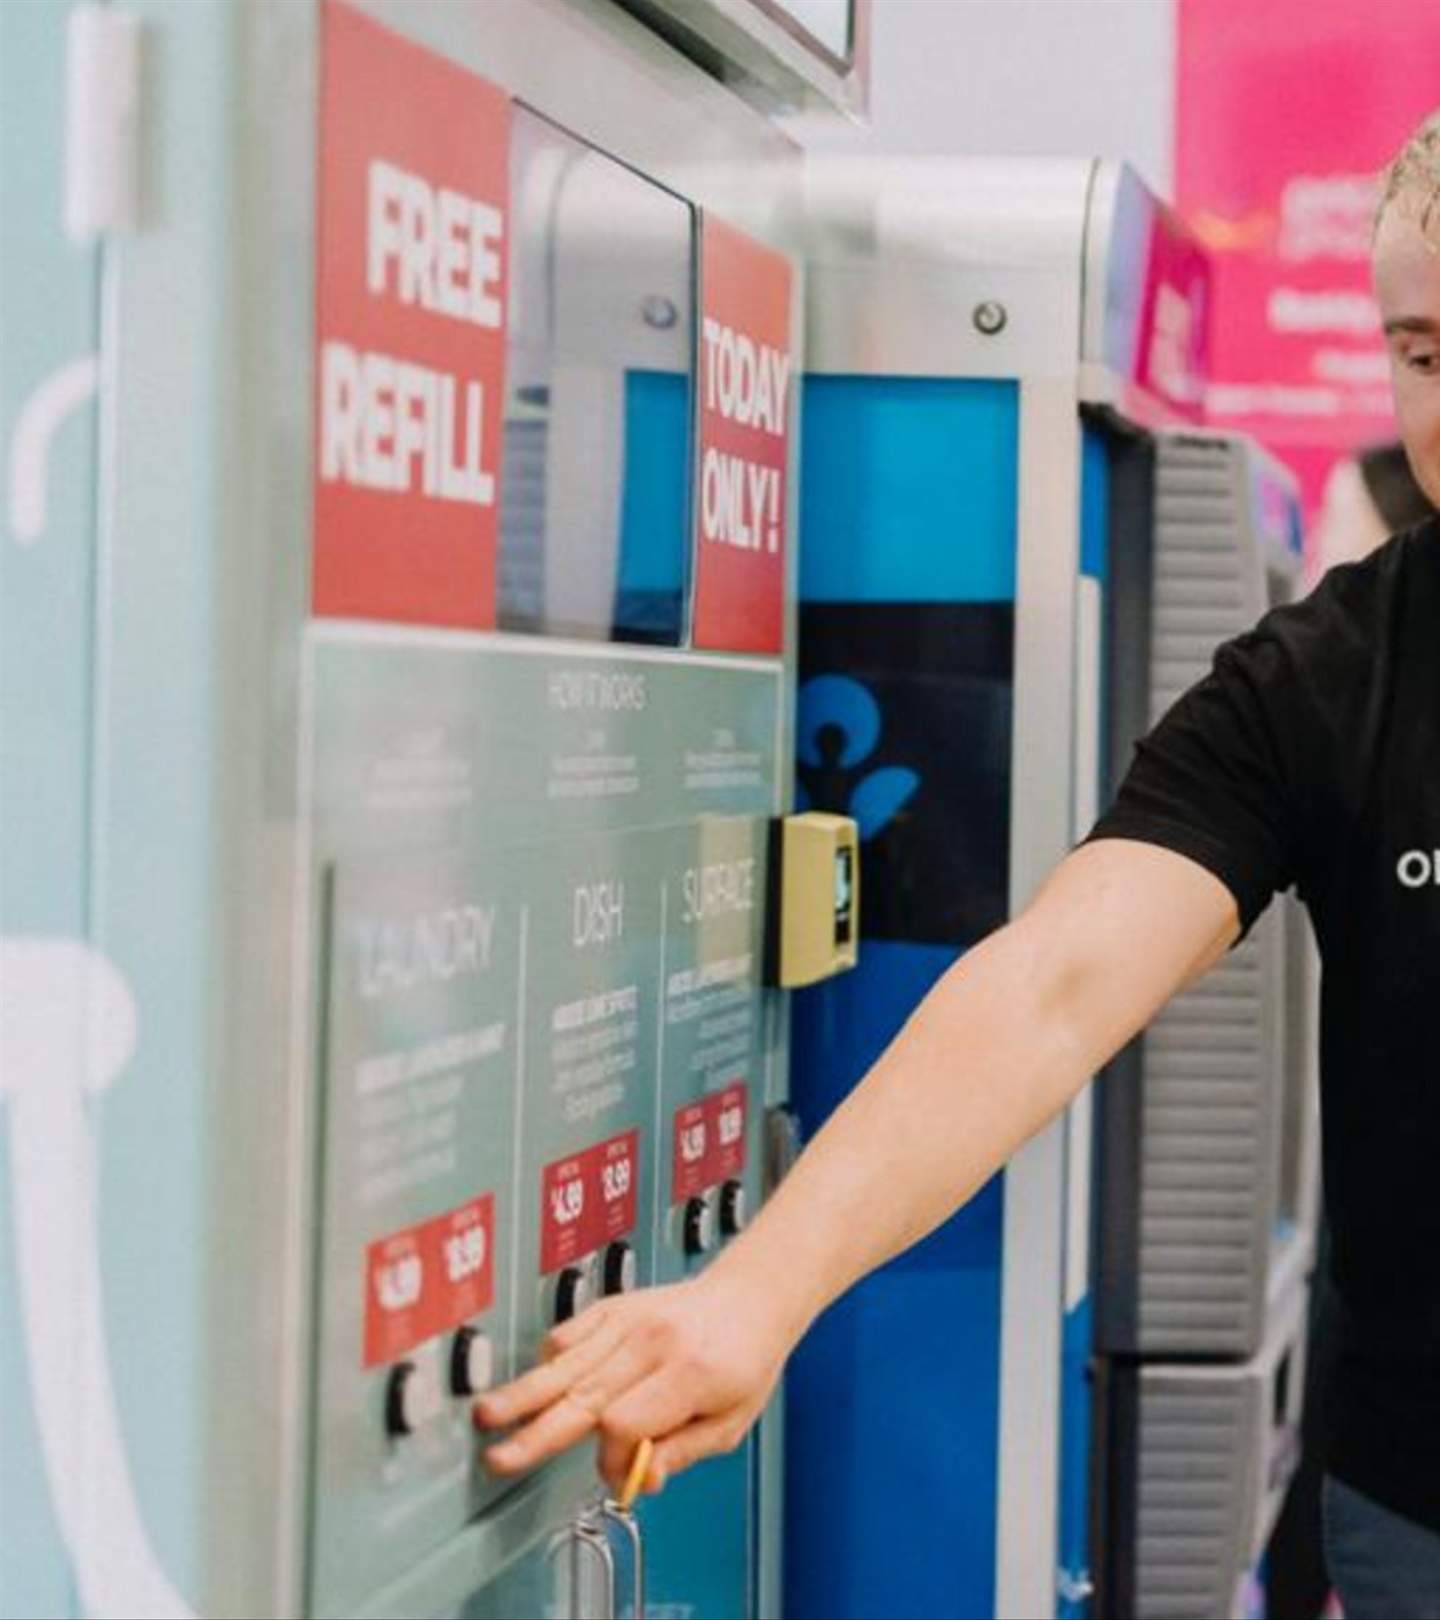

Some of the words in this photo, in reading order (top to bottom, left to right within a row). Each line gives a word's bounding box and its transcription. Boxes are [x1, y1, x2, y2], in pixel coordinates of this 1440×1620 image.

[366, 159, 503, 328] FREE
[319, 339, 495, 508] REFILL
[702, 318, 790, 436] TODAY
[702, 446, 782, 554] ONLY!
[357, 903, 497, 998] LAUNDRY
[572, 880, 624, 948] DISH
